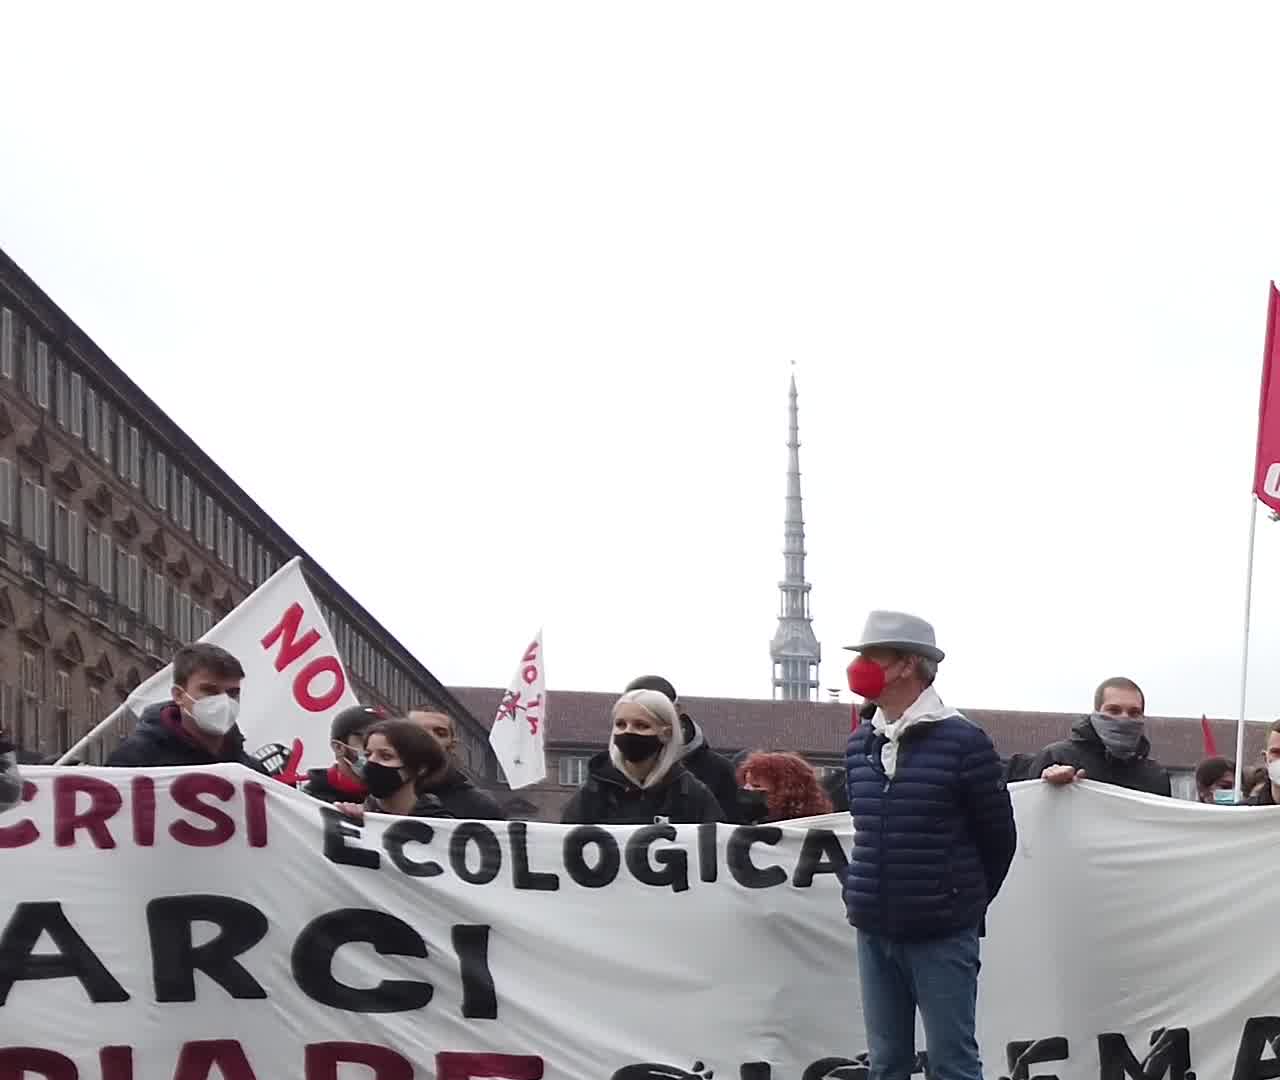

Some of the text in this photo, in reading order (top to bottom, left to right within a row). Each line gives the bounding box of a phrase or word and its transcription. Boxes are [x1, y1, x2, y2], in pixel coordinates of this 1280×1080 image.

[260, 601, 346, 713] NO
[319, 806, 848, 892] ECOLOGICA
[0, 895, 498, 1020] ARCI
